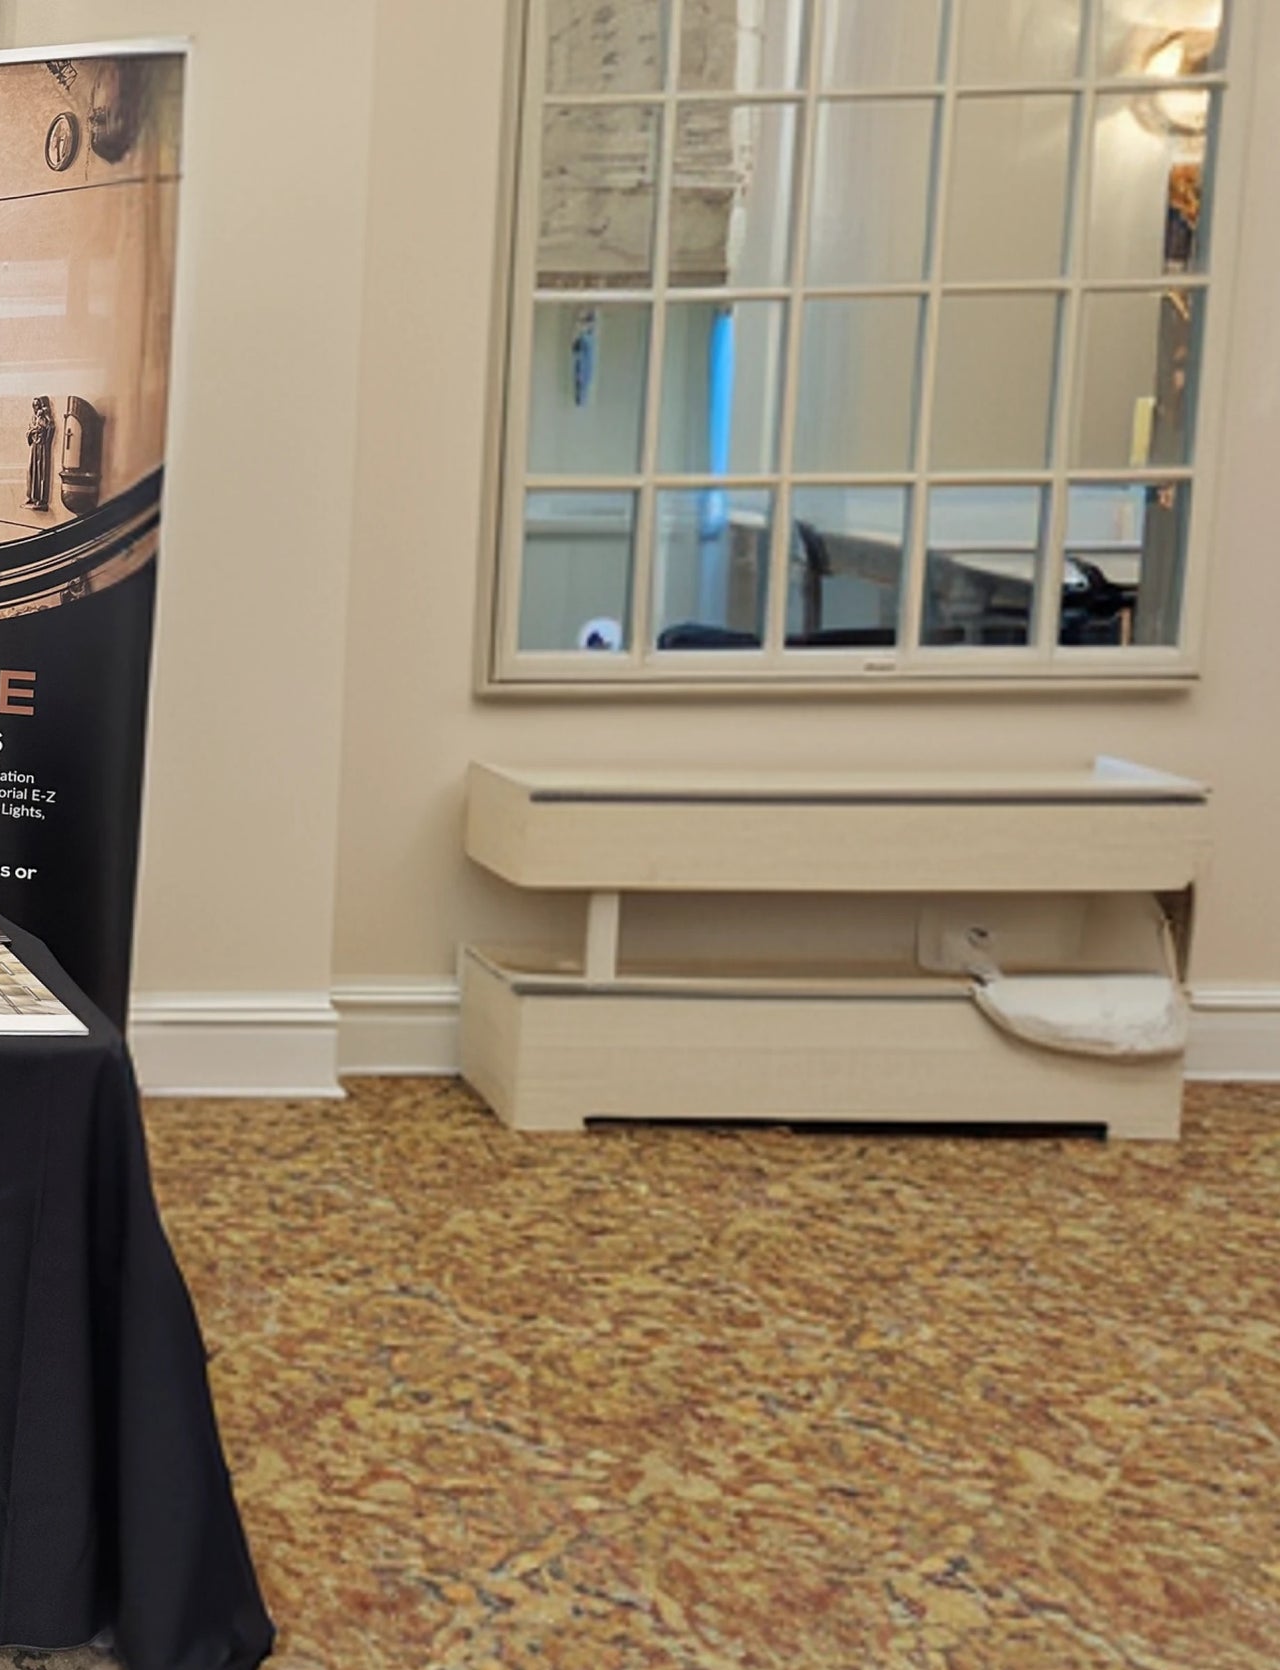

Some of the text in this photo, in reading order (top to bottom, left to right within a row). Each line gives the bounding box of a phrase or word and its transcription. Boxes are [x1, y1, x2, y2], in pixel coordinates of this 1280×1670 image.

[32, 789, 56, 803] E-Z
[1, 803, 46, 820] Lights,
[14, 867, 38, 880] or
